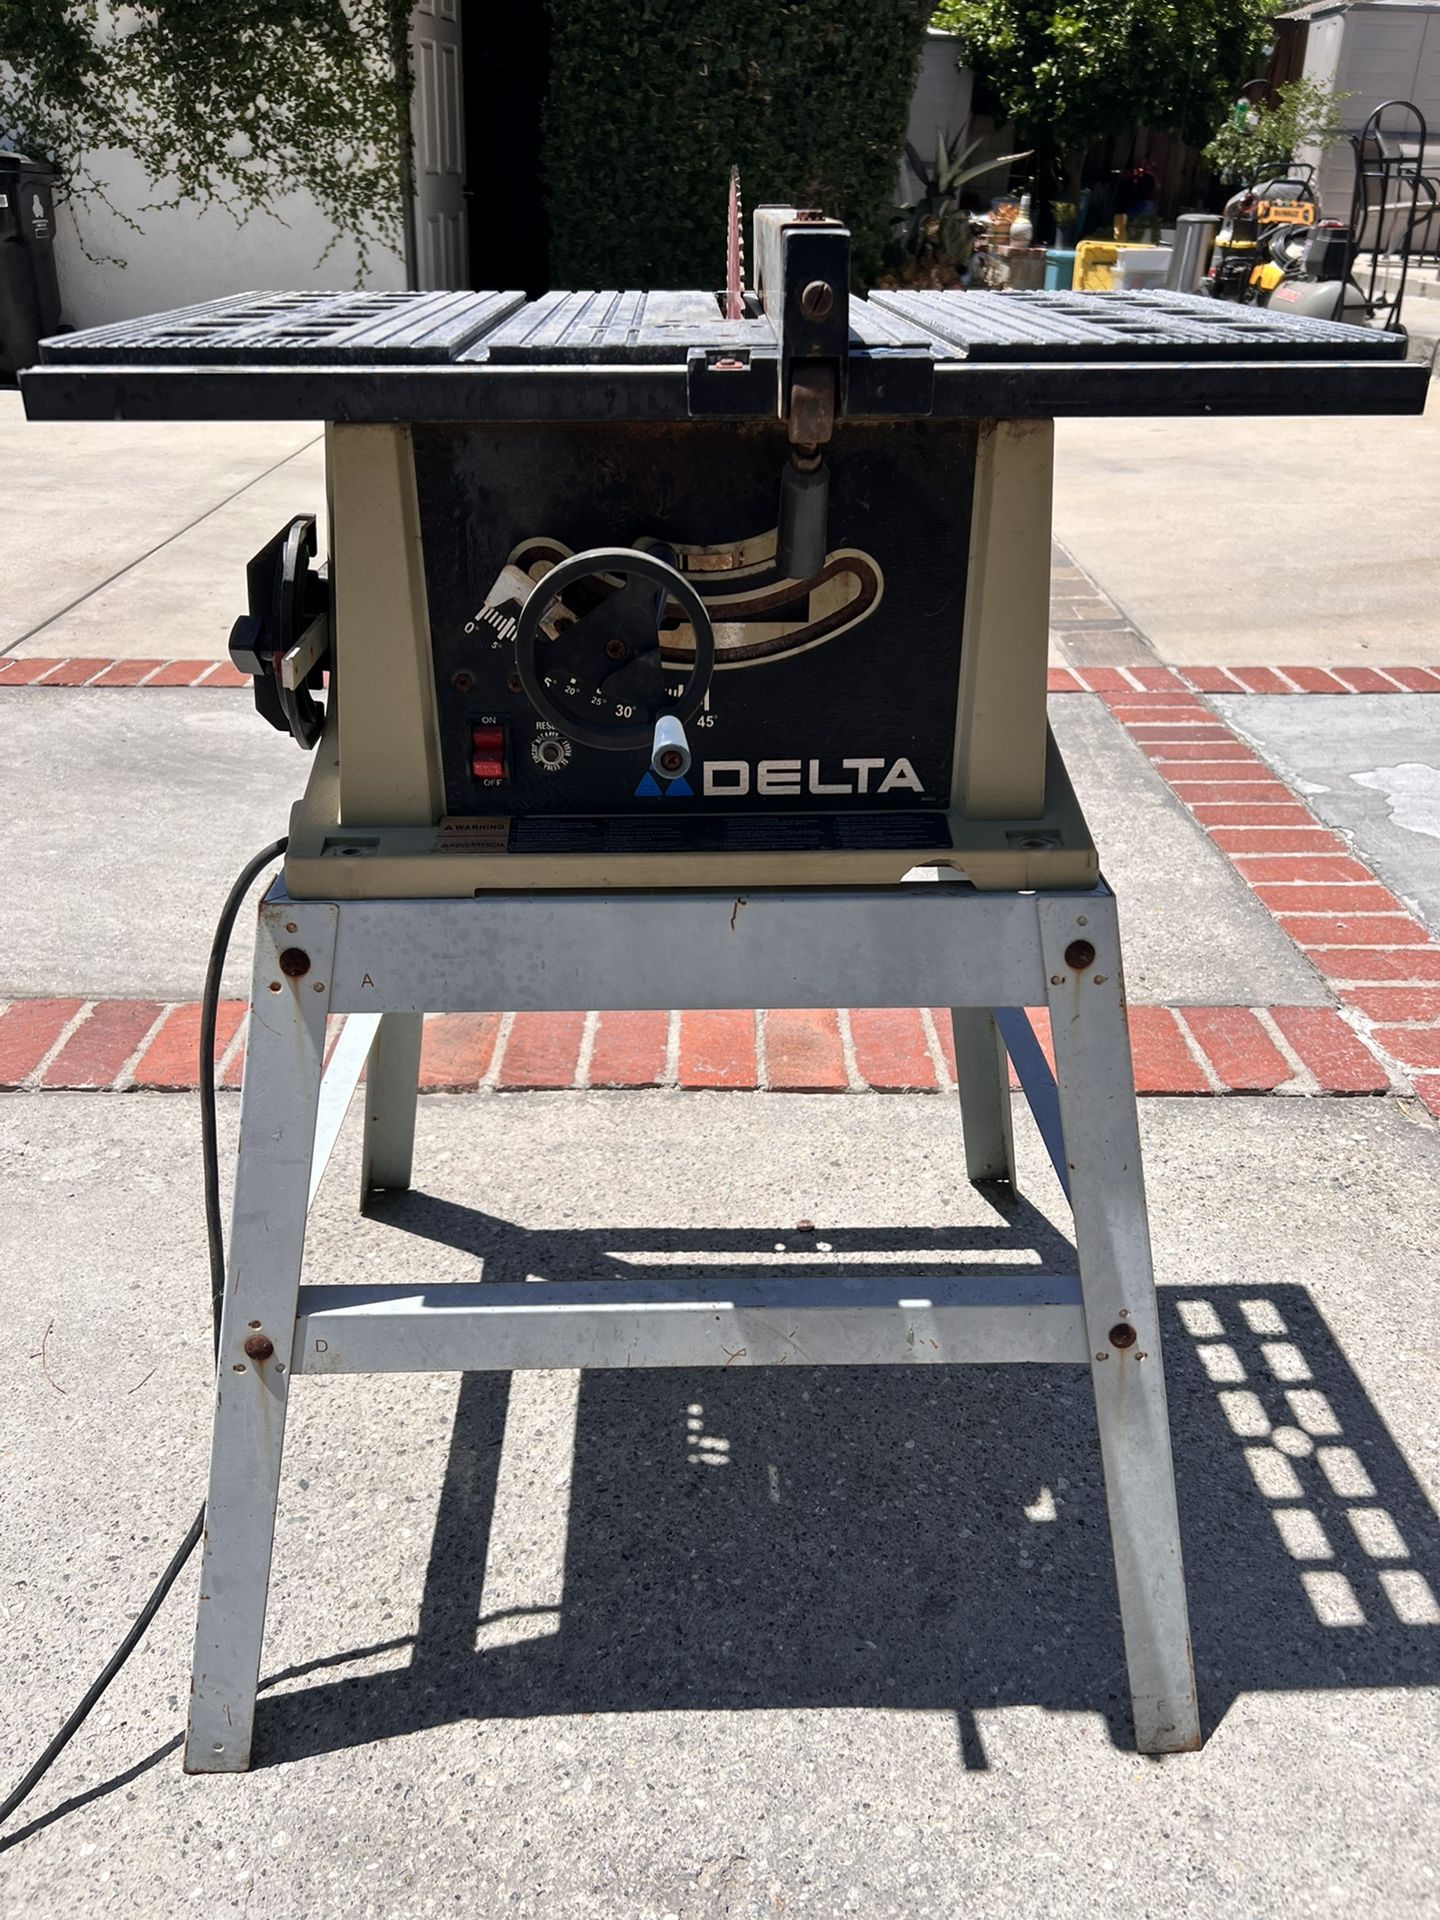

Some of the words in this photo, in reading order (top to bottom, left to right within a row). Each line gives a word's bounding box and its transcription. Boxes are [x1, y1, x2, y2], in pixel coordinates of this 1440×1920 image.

[481, 716, 497, 724] ON
[483, 779, 502, 787] OFF
[703, 757, 925, 796] DELTA
[361, 973, 375, 988] A
[315, 1339, 329, 1353] D
